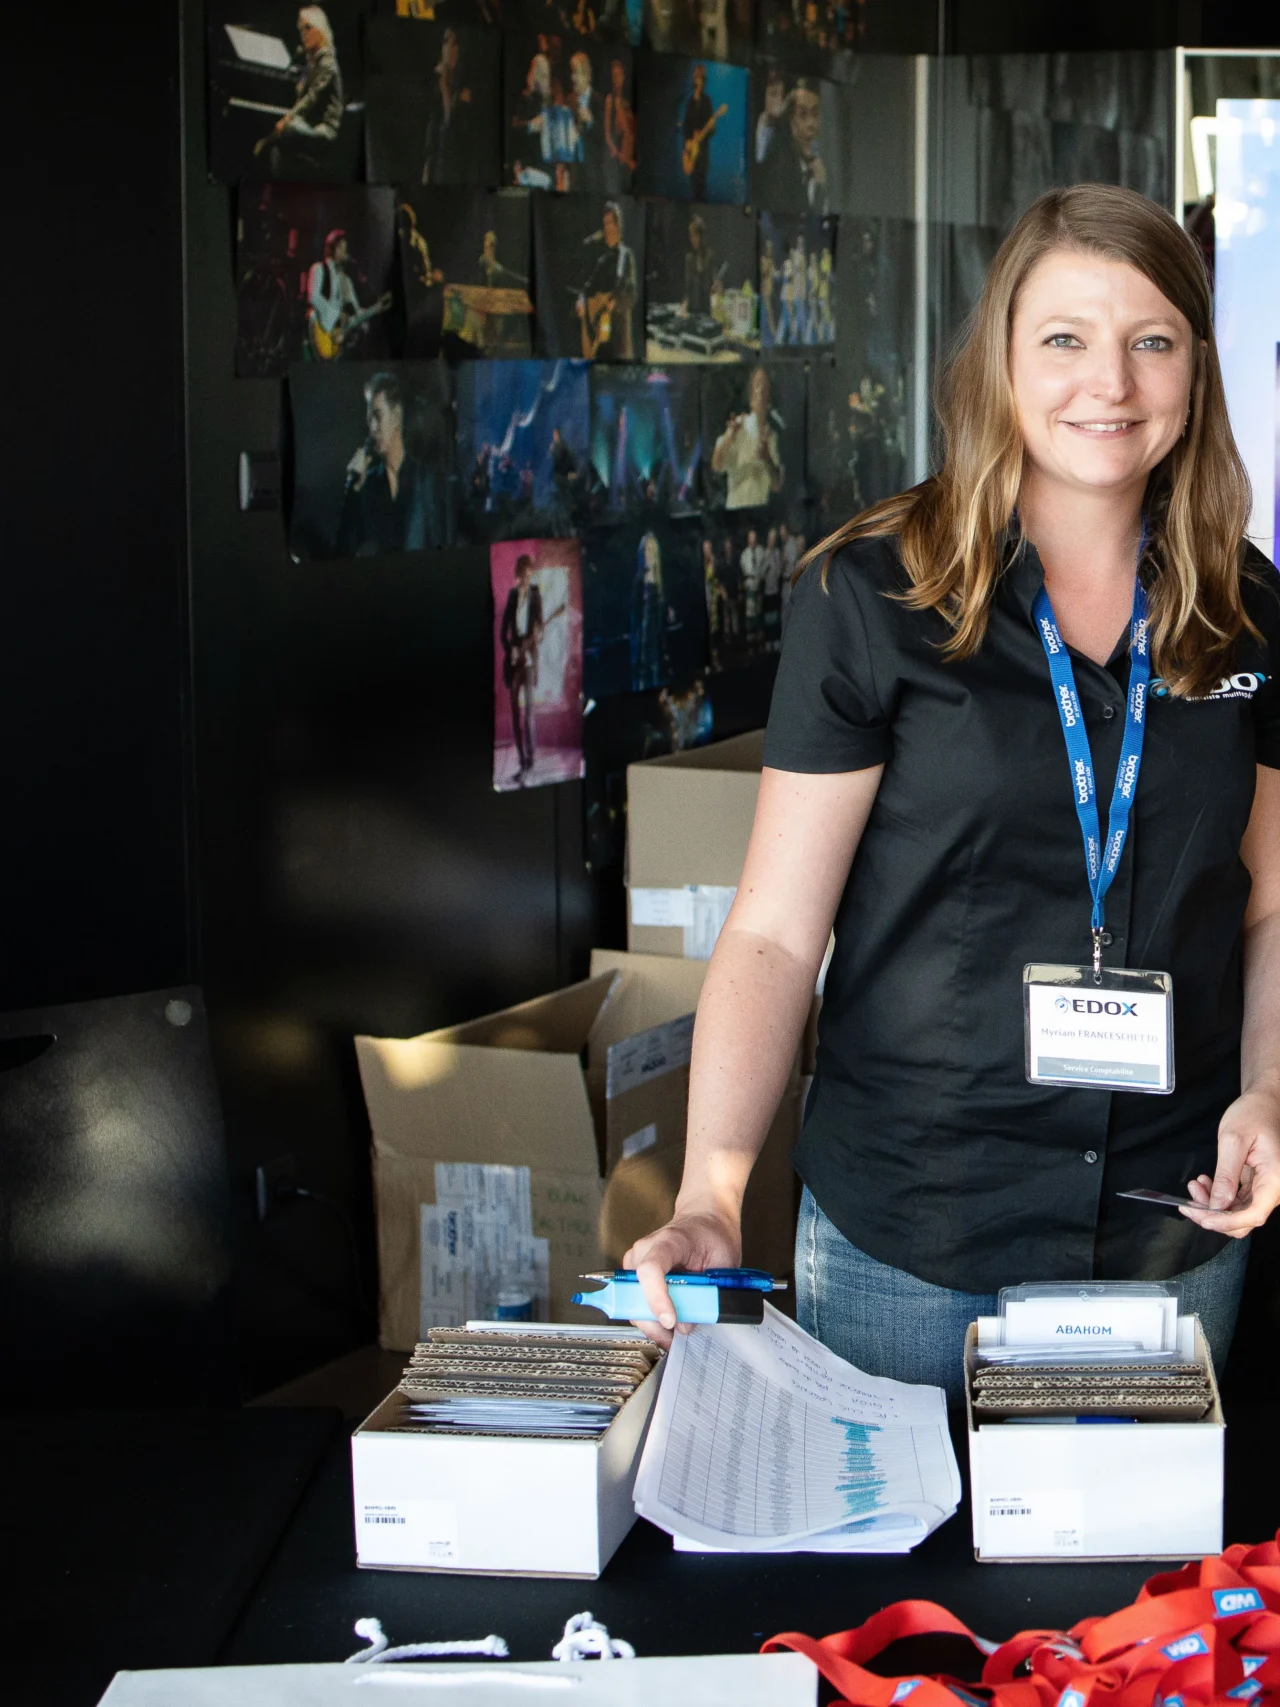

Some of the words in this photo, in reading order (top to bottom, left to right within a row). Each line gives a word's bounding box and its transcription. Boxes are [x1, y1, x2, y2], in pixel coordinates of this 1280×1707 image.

[1072, 999, 1138, 1017] EDOX
[1041, 1027, 1076, 1039] Myriam
[1063, 1064, 1089, 1074] Service
[1090, 1066, 1134, 1077] Comptabilité
[1220, 1592, 1257, 1612] WD
